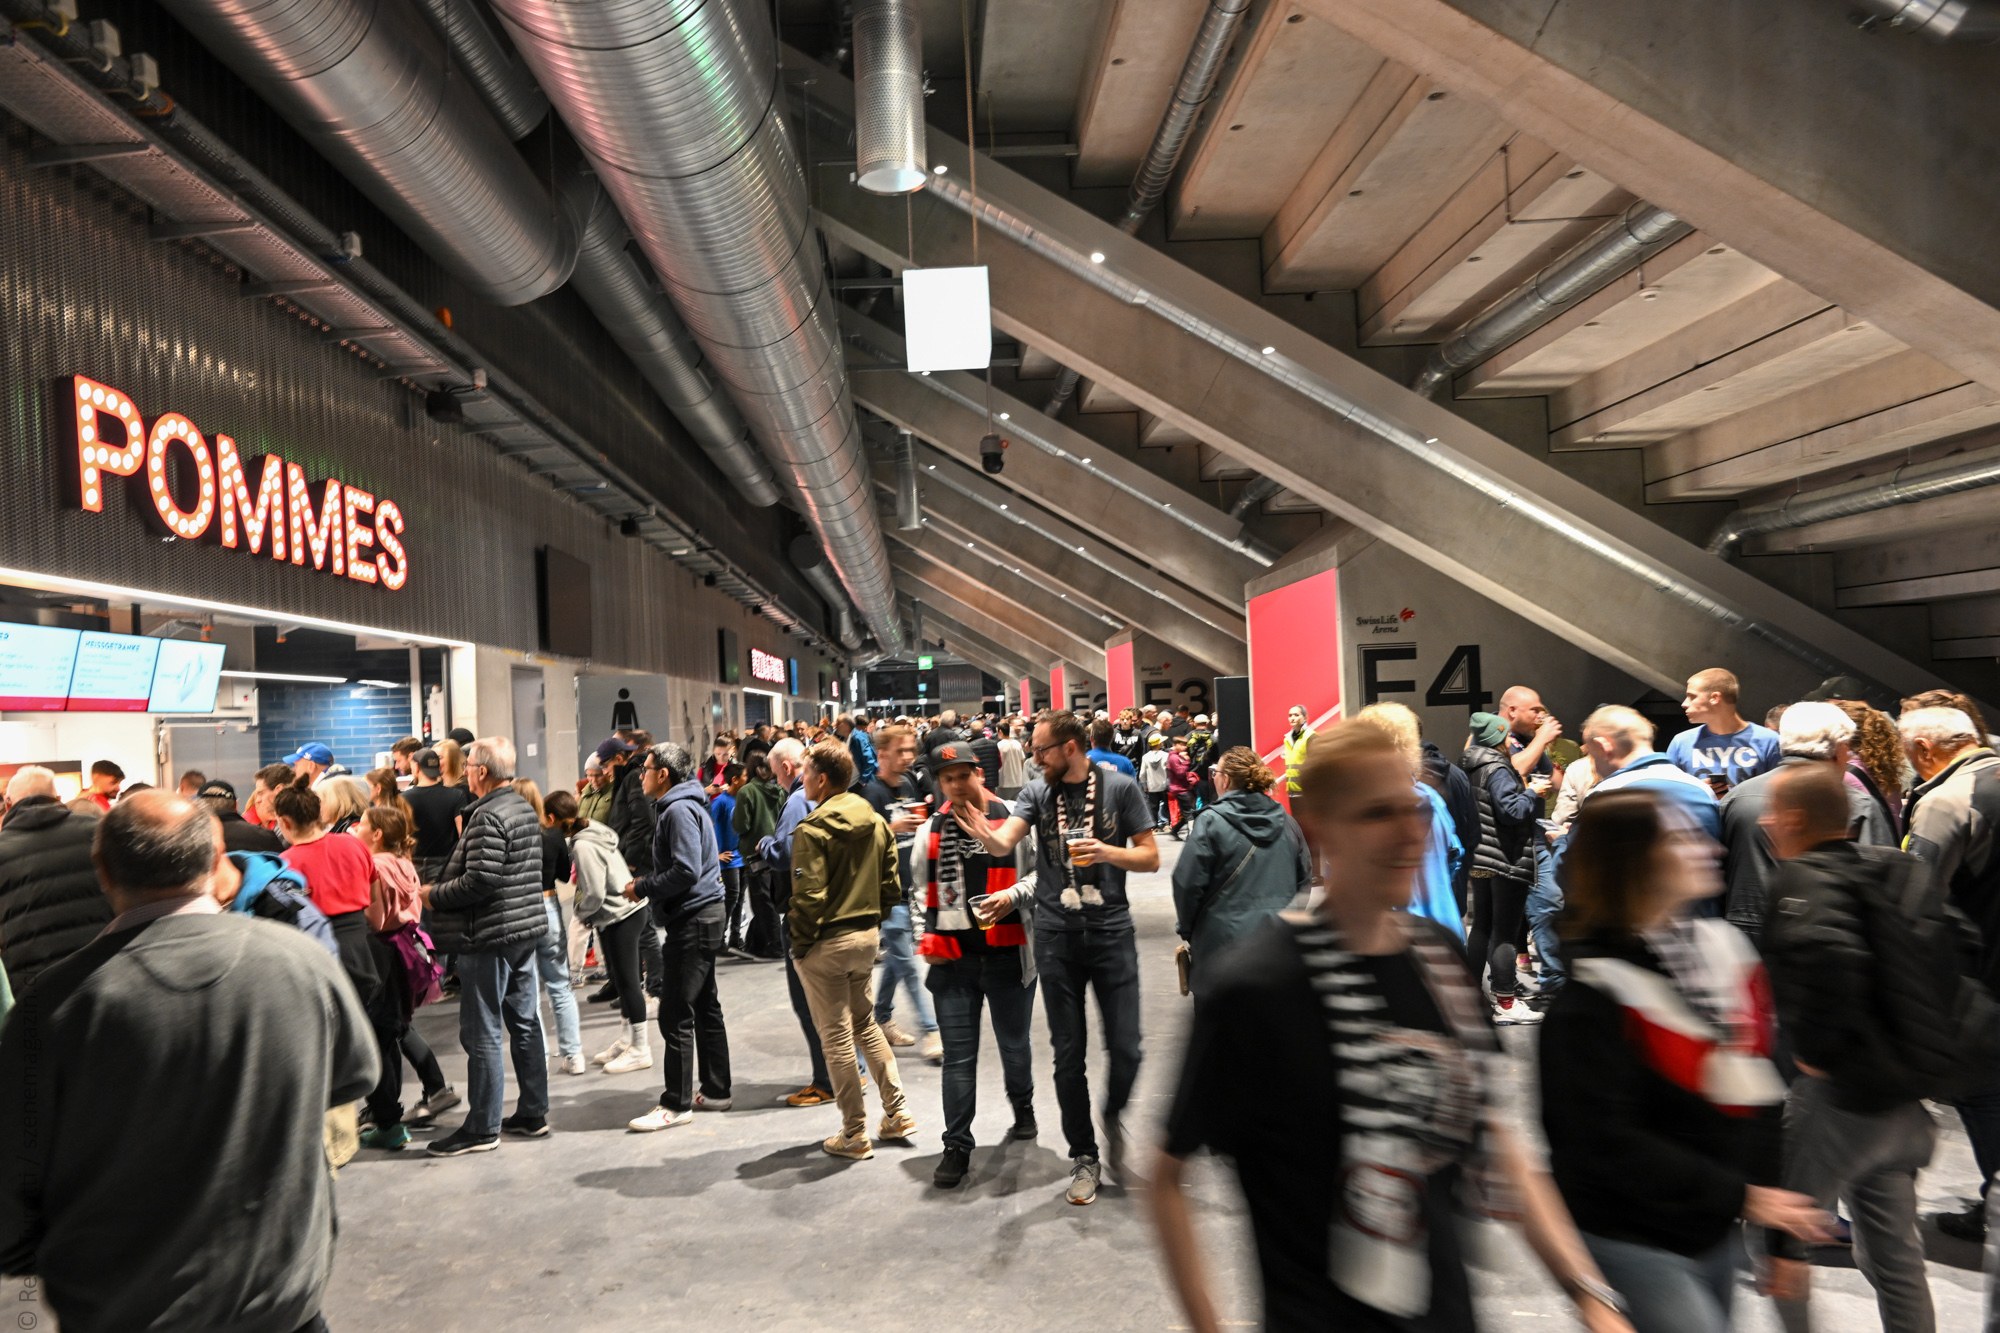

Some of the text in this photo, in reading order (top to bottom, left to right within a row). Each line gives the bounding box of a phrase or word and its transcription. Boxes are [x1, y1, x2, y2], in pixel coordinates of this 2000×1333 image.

[75, 374, 407, 590] POMMES
[1372, 626, 1399, 634] Arena
[1692, 746, 1759, 768] NYC
